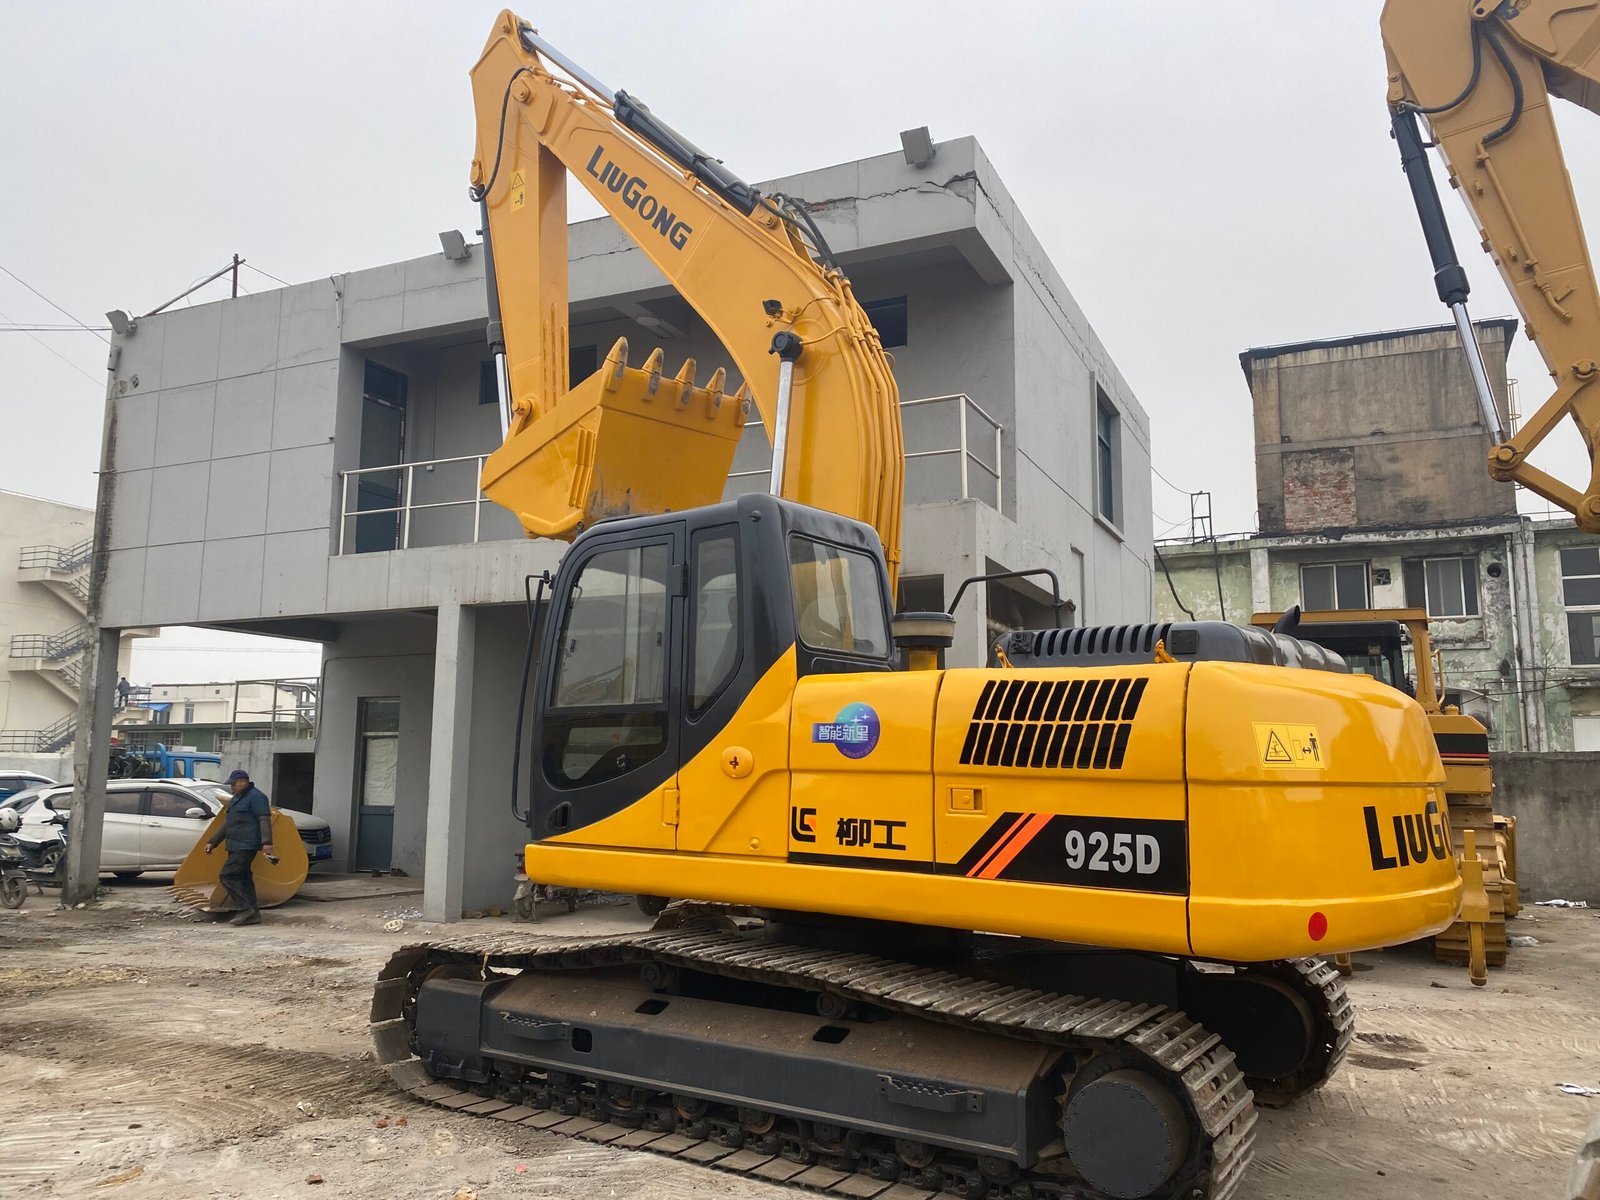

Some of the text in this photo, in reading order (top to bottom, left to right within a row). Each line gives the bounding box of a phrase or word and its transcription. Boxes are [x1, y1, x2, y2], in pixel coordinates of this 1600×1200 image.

[818, 724, 869, 742] 智能新星
[835, 817, 907, 851] 柳工
[1065, 830, 1161, 875] 925D
